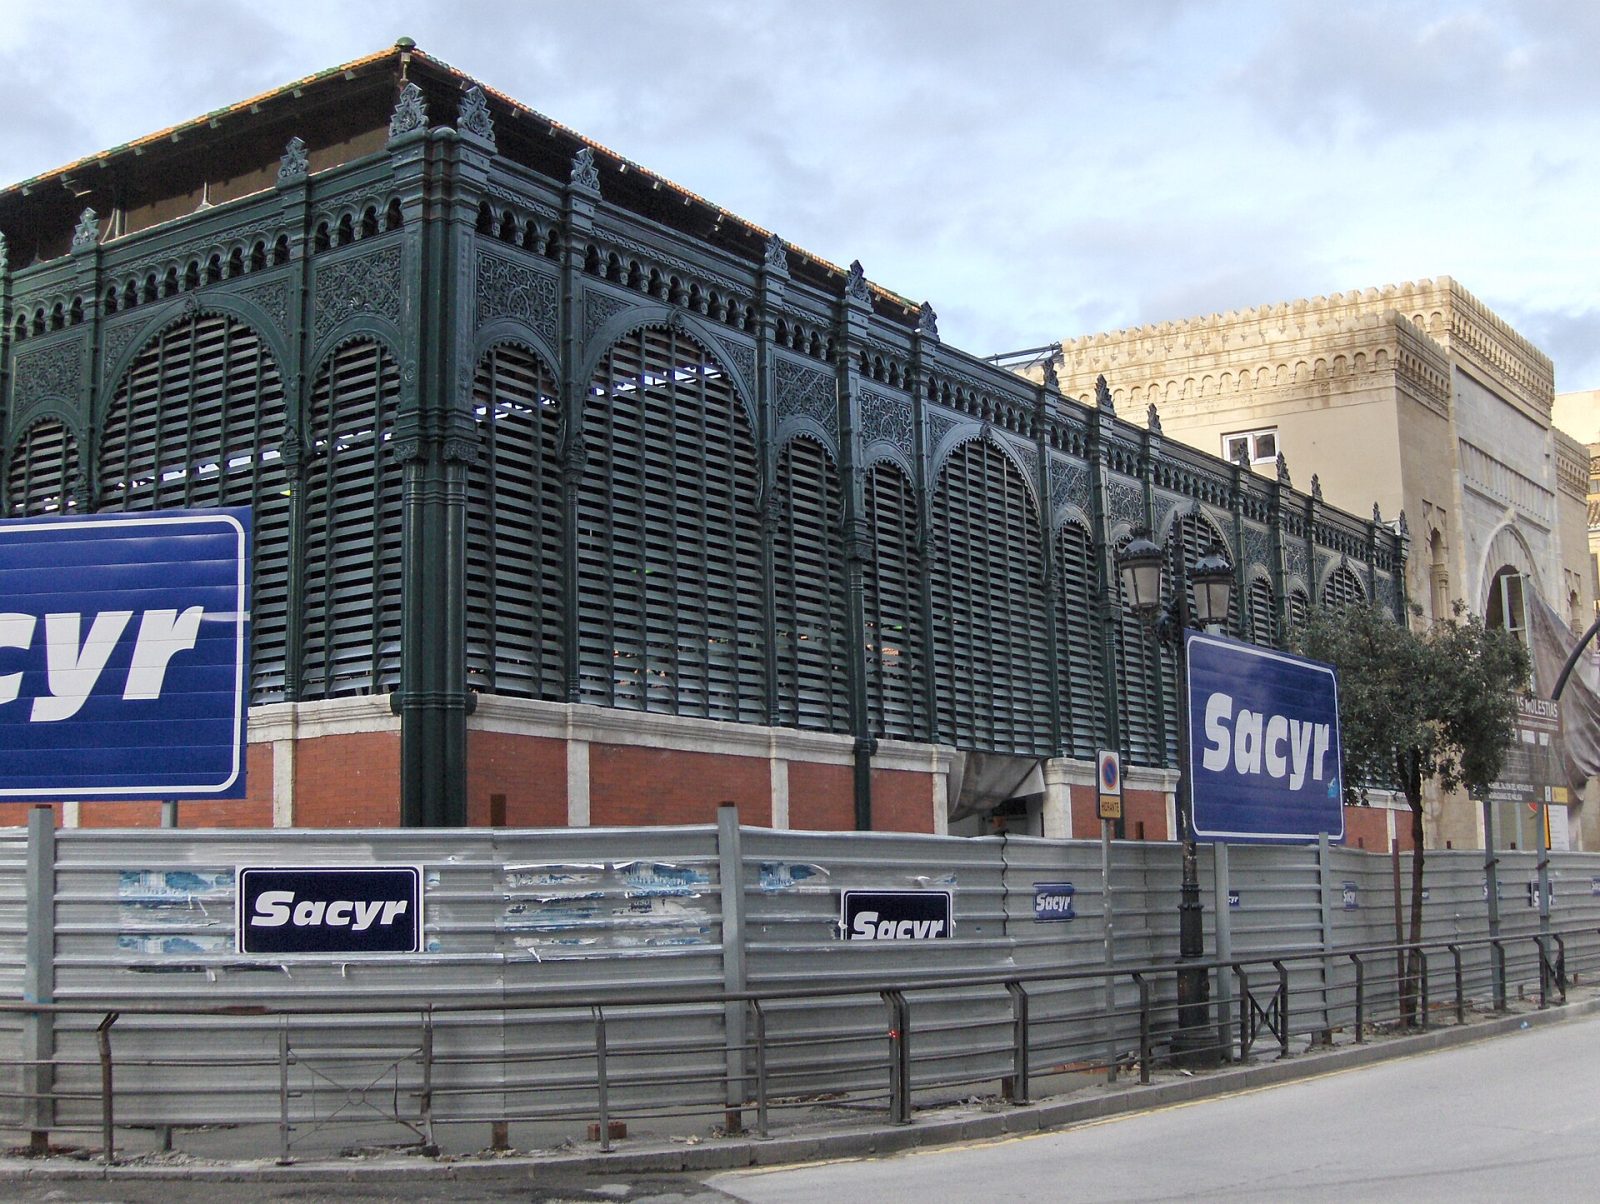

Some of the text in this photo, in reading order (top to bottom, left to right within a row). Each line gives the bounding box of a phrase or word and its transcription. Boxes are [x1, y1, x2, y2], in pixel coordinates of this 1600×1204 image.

[1203, 692, 1329, 790] Sacyr
[251, 891, 408, 931] Sacyr
[1036, 892, 1071, 912] Sacyr
[851, 911, 944, 940] Sacyr
